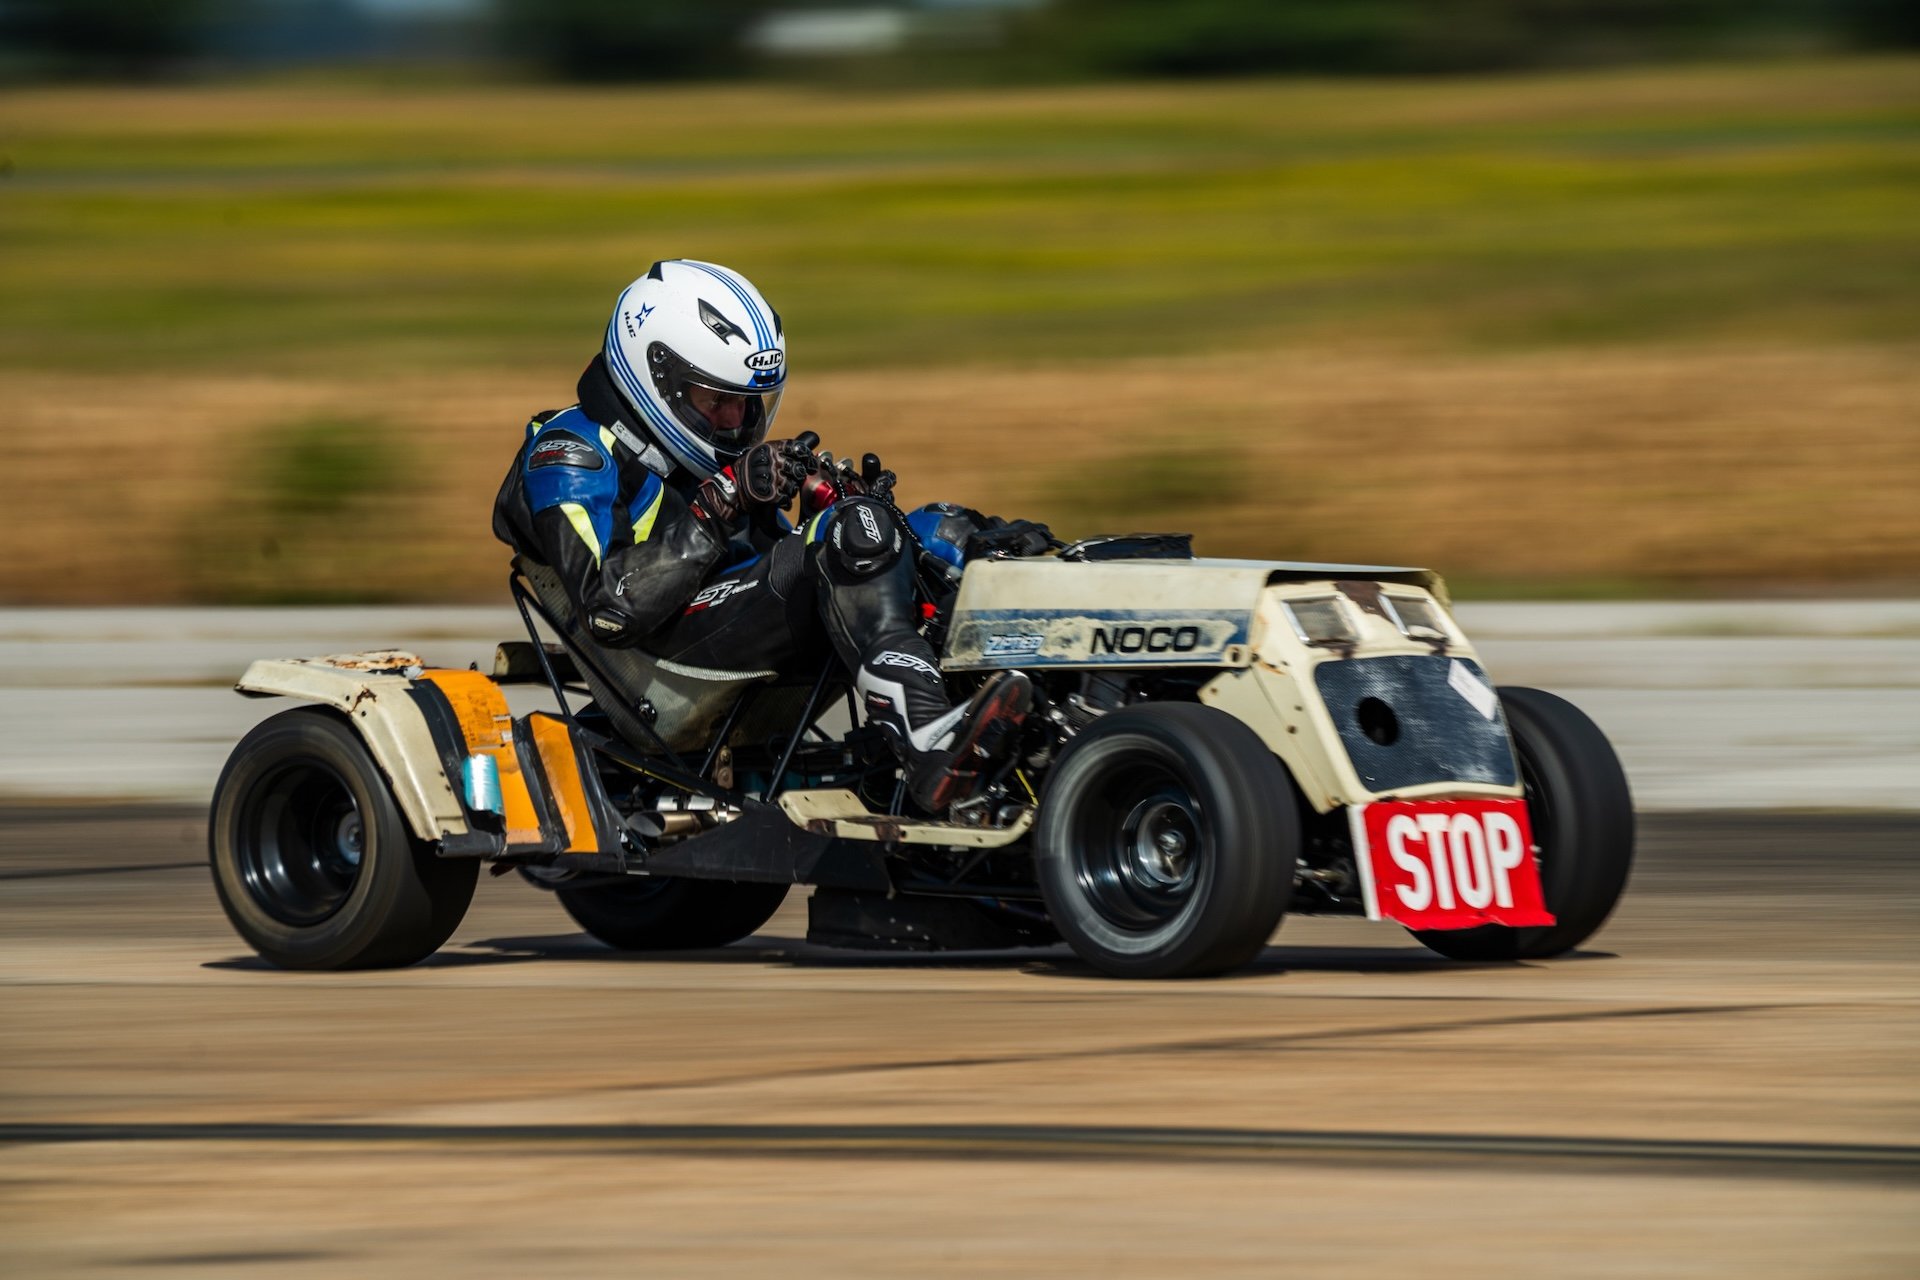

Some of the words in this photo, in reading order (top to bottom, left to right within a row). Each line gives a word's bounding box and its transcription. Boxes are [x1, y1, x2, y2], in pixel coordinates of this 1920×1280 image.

[752, 352, 781, 367] HJC
[856, 504, 883, 544] RST
[690, 578, 741, 607] ST
[1091, 625, 1200, 654] NOCO
[872, 650, 942, 679] RST
[1386, 812, 1523, 911] STOP
